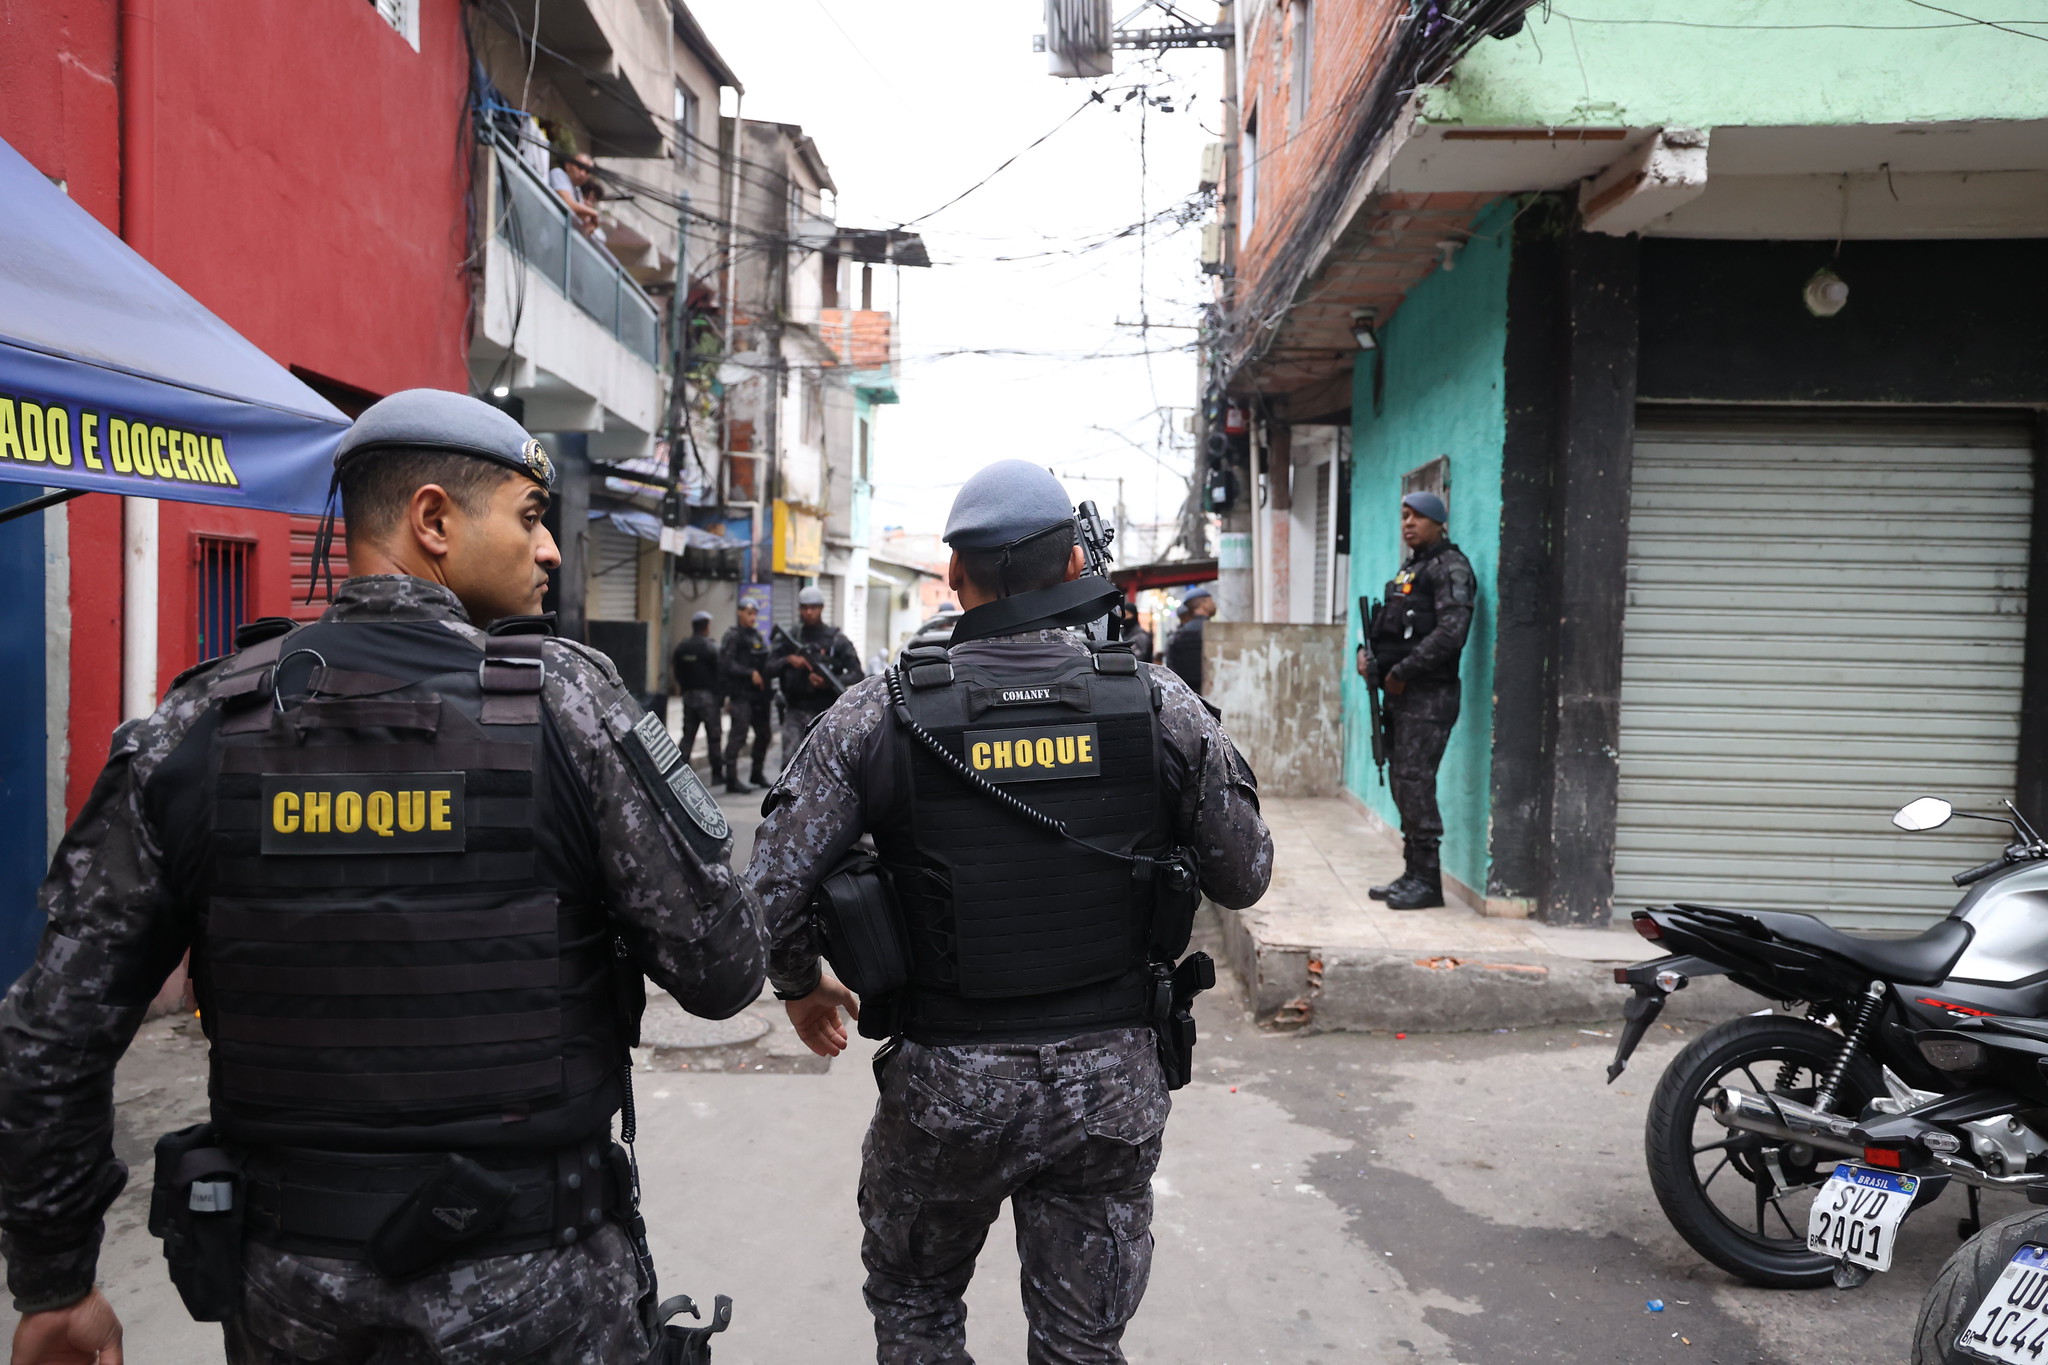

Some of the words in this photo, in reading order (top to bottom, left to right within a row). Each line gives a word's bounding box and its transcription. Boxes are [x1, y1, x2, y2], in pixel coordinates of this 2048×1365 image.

[82, 413, 104, 469] E
[110, 418, 238, 486] DOCERIA
[971, 734, 1093, 770] CHOQUE
[272, 790, 452, 837] CHOQUE
[1832, 1185, 1889, 1220] SVD
[1857, 1175, 1888, 1189] BRASIL
[2007, 1269, 2048, 1316] UD
[1973, 1306, 2048, 1360] 1C44
